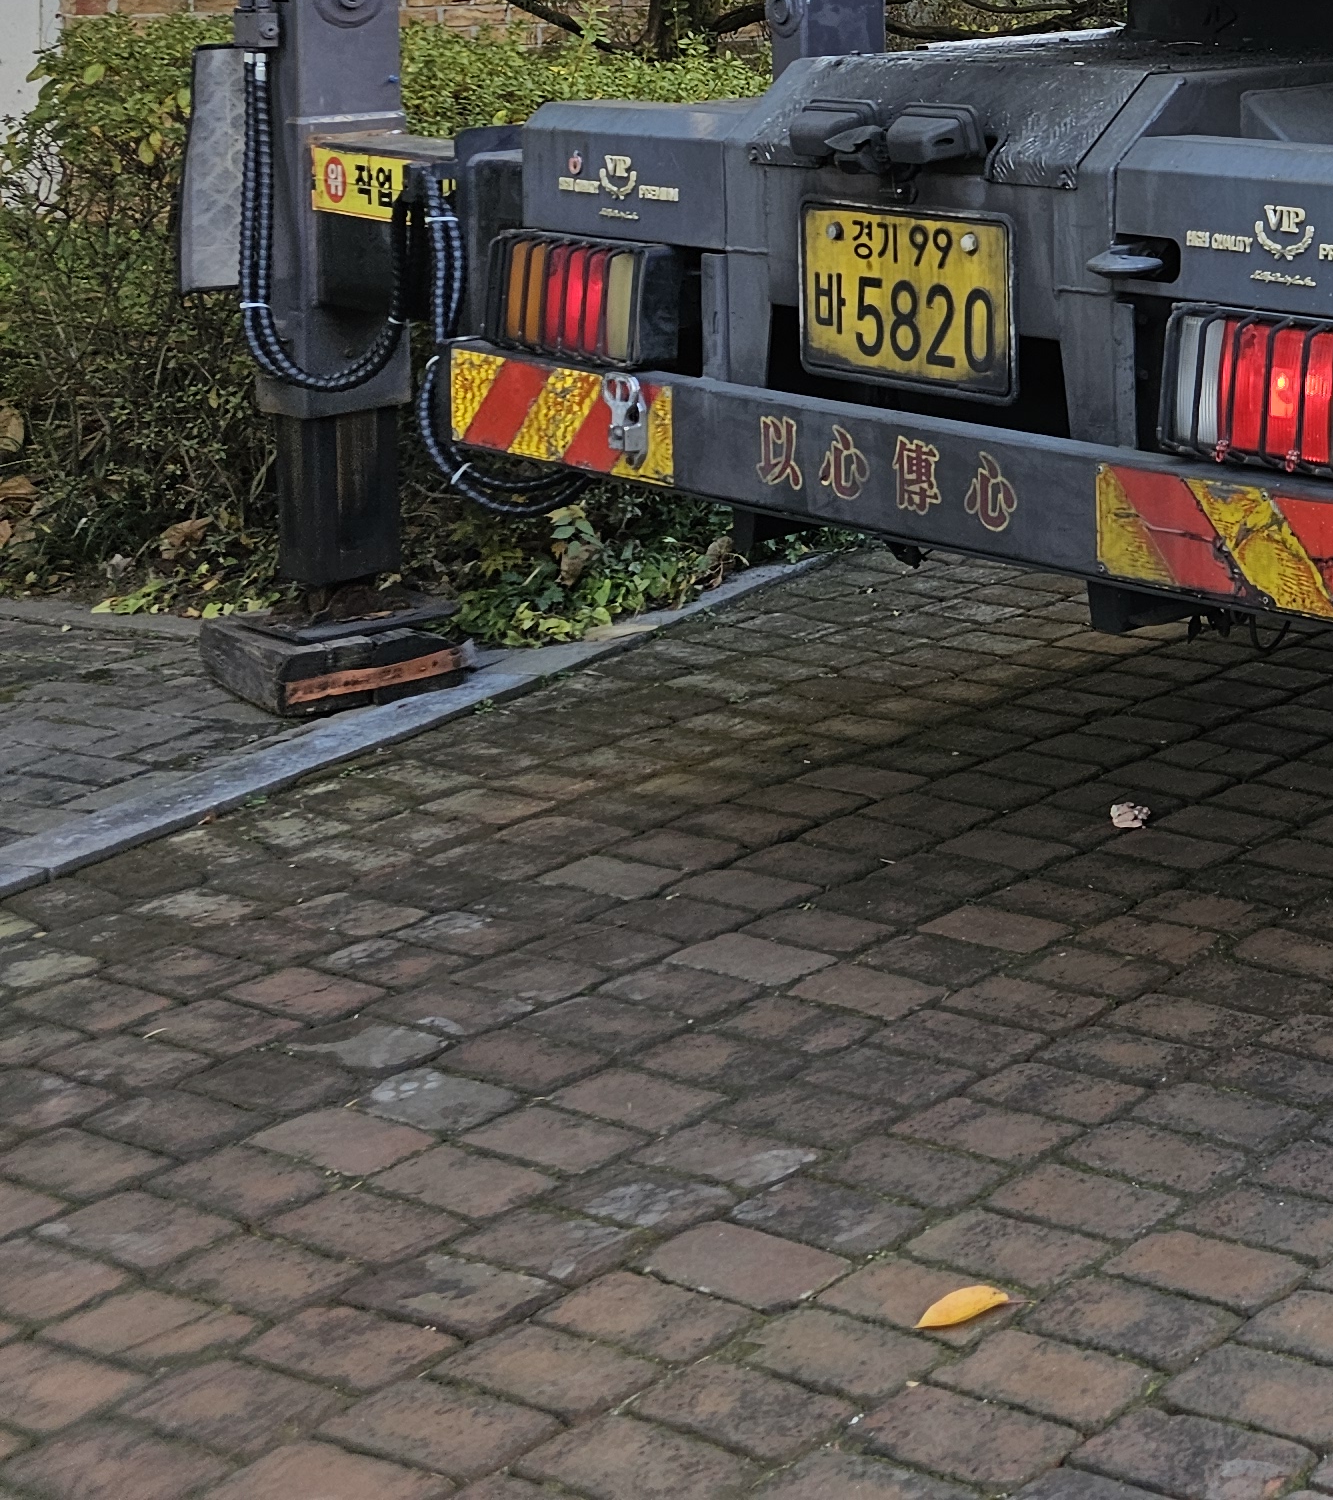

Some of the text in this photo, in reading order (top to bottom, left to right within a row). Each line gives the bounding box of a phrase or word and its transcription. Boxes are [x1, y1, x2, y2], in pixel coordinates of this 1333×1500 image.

[327, 163, 343, 196] 위
[604, 155, 632, 177] VIP
[1263, 205, 1306, 233] VIP
[852, 219, 953, 270] 경기 99
[1186, 230, 1210, 248] HIGH
[1211, 233, 1253, 253] QUALITY
[814, 271, 994, 373] 바 5820
[757, 416, 1018, 532] 以心傳心
